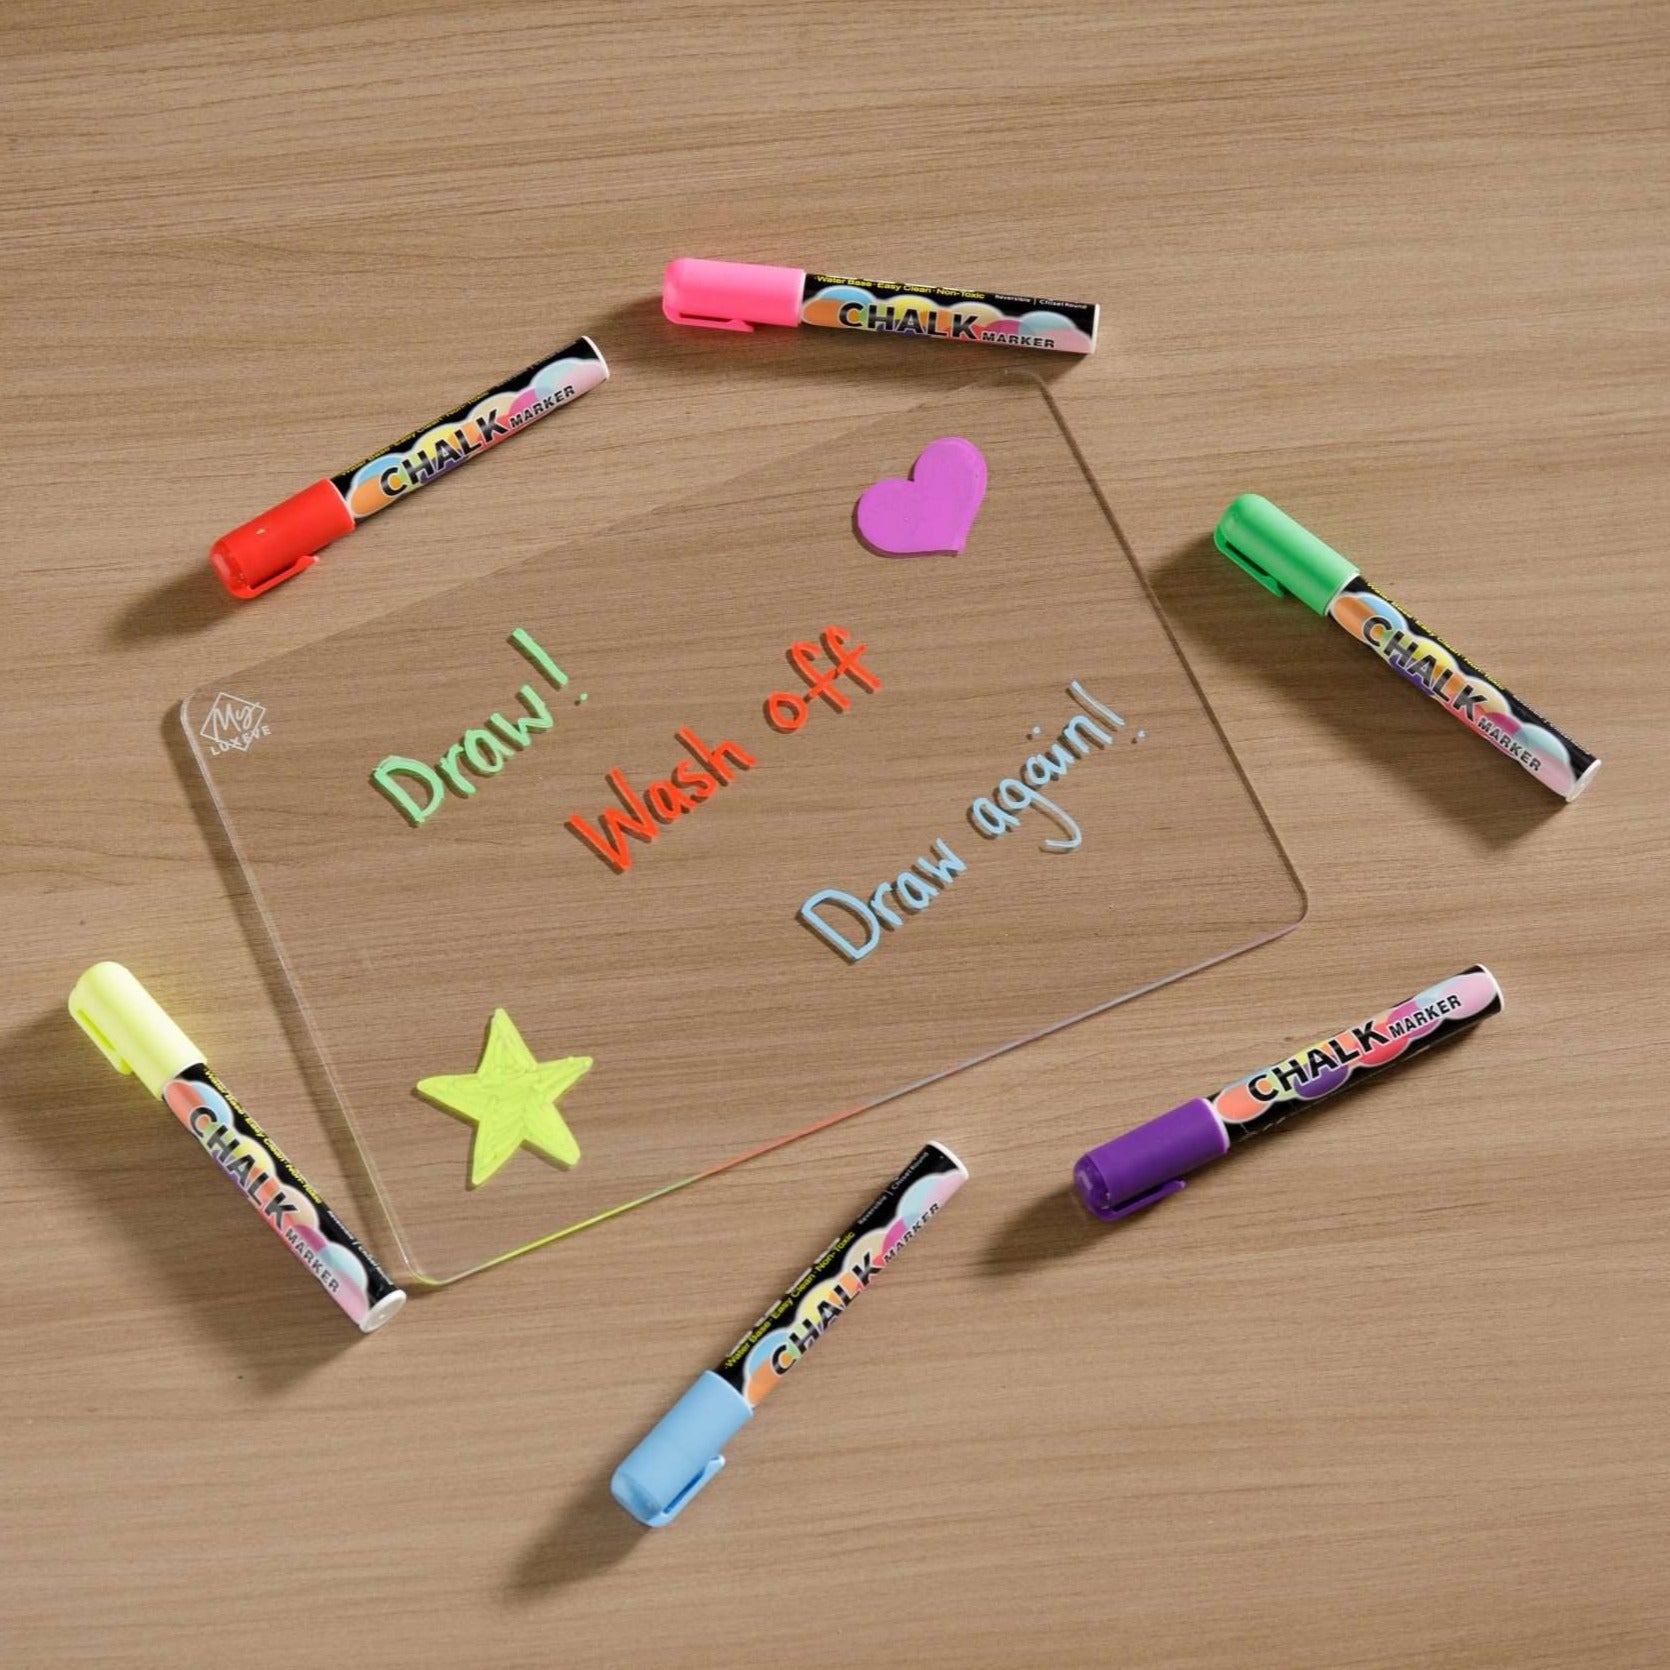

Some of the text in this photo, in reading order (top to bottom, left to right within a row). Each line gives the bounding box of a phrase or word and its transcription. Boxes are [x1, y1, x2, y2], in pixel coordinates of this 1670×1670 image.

[838, 301, 1055, 349] CHALK MARKER
[877, 280, 902, 292] Easy
[903, 284, 932, 294] Clean
[936, 288, 986, 300] Non-Toxic
[380, 408, 509, 497] CHALK
[510, 385, 576, 428] MARKER
[373, 627, 589, 823] Draw!
[569, 625, 883, 871] Wash off
[1363, 616, 1488, 721] CHALK
[1477, 717, 1542, 771] MARKER
[801, 679, 1147, 961] Draw again!
[1247, 994, 1462, 1103] CHALK MARKER
[190, 1107, 340, 1293] CHALK MARKER
[725, 1232, 856, 1368] Water Base Easy Clean Non-Toxic
[771, 1203, 940, 1376] CHALK MARKER
